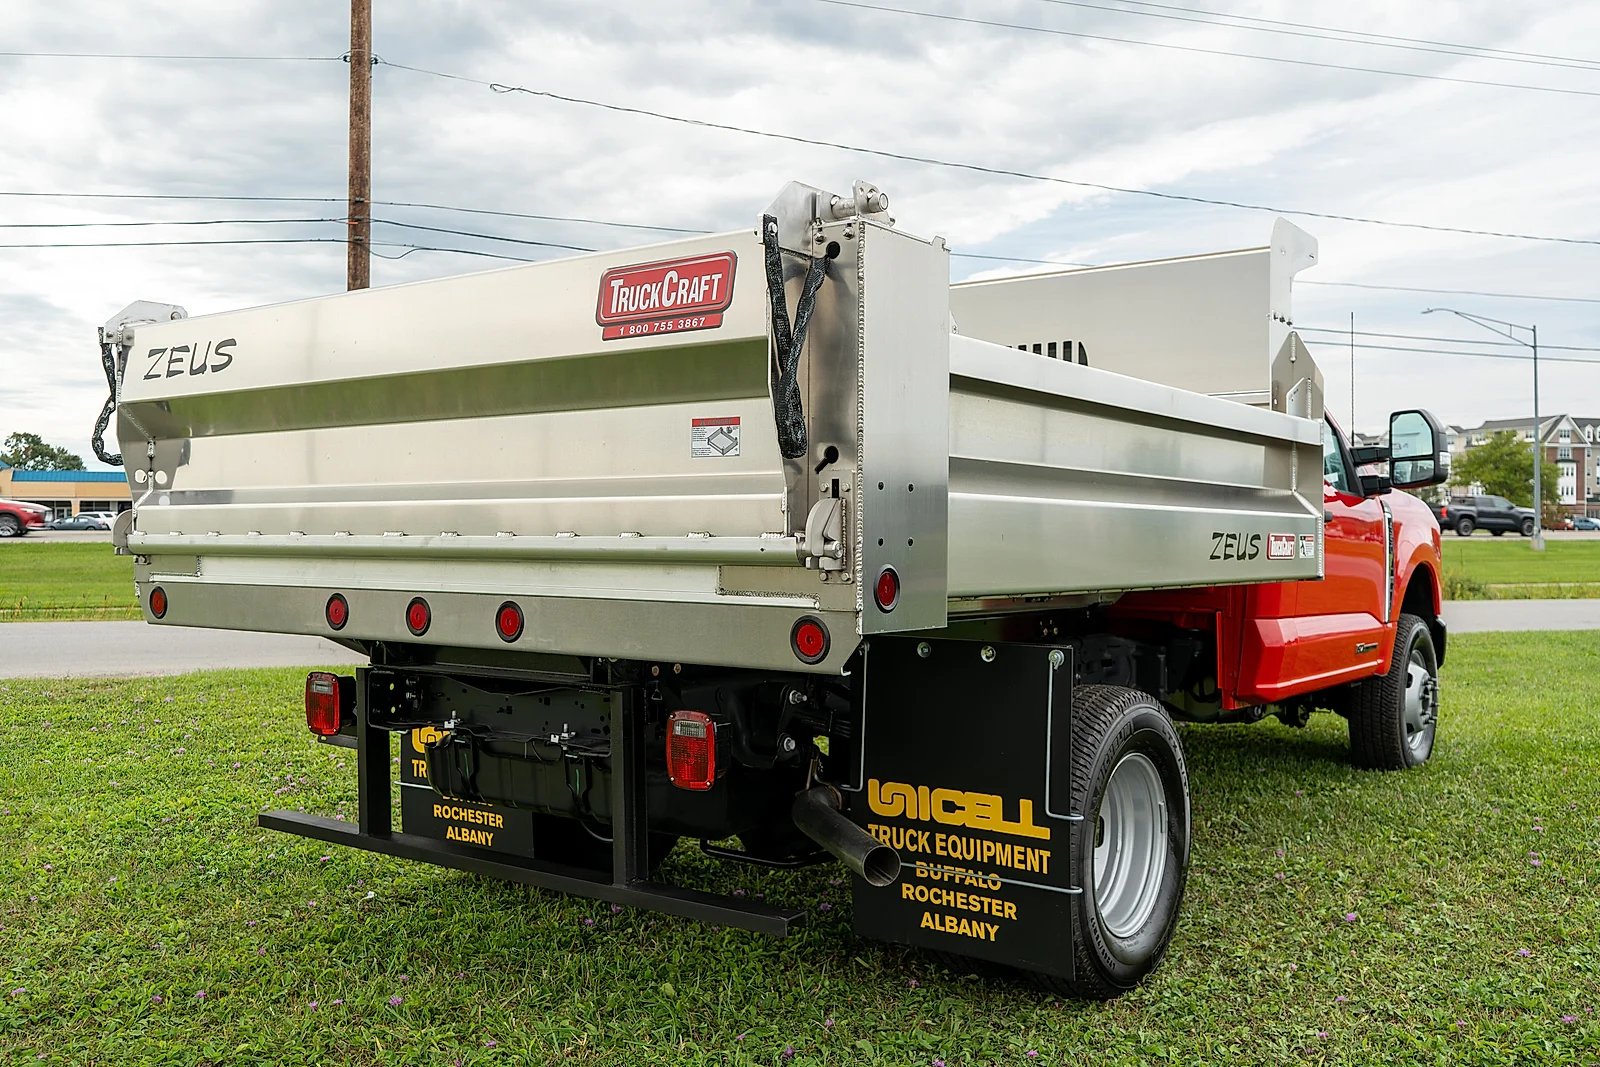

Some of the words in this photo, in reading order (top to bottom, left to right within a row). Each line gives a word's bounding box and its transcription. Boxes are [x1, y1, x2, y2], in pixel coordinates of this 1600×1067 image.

[619, 326, 625, 335] 1
[629, 323, 649, 335] 800
[653, 320, 673, 332] 755
[678, 317, 706, 329] 3867
[143, 338, 237, 380] ZEUS
[1209, 532, 1261, 560] ZEUS
[433, 804, 504, 828] ROCHESTER
[868, 779, 1050, 840] UNICELL
[446, 826, 494, 847] ALBANY
[868, 824, 932, 854] TRUCK
[935, 833, 1051, 874] EQUIPMENT
[915, 861, 1002, 891] BUFFALO
[901, 883, 1018, 920] ROCHESTER
[920, 912, 1000, 942] ALBANY
